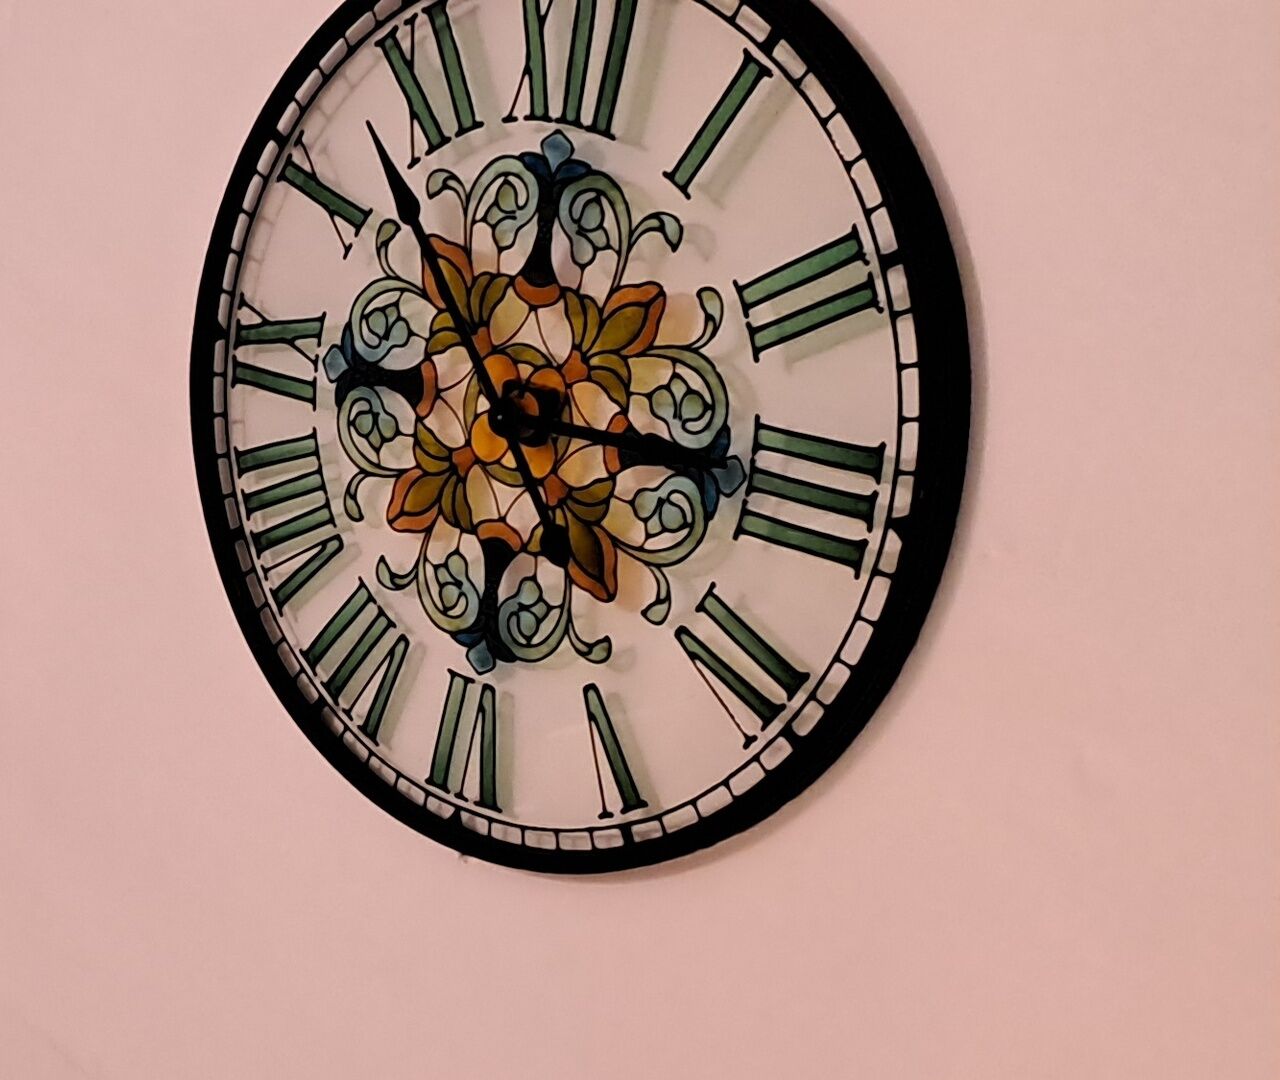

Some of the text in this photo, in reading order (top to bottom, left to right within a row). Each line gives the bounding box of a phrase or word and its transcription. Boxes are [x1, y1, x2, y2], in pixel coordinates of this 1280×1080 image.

[374, 4, 484, 169] XI
[502, 0, 639, 140] XII
[662, 48, 773, 200] I
[277, 130, 372, 259] X
[230, 291, 327, 411] IX
[733, 223, 885, 363] II
[233, 426, 345, 617] VIII
[733, 414, 887, 580] III
[299, 576, 411, 747] VII
[674, 581, 811, 749] IV
[425, 668, 503, 813] VI
[583, 682, 649, 819] V
